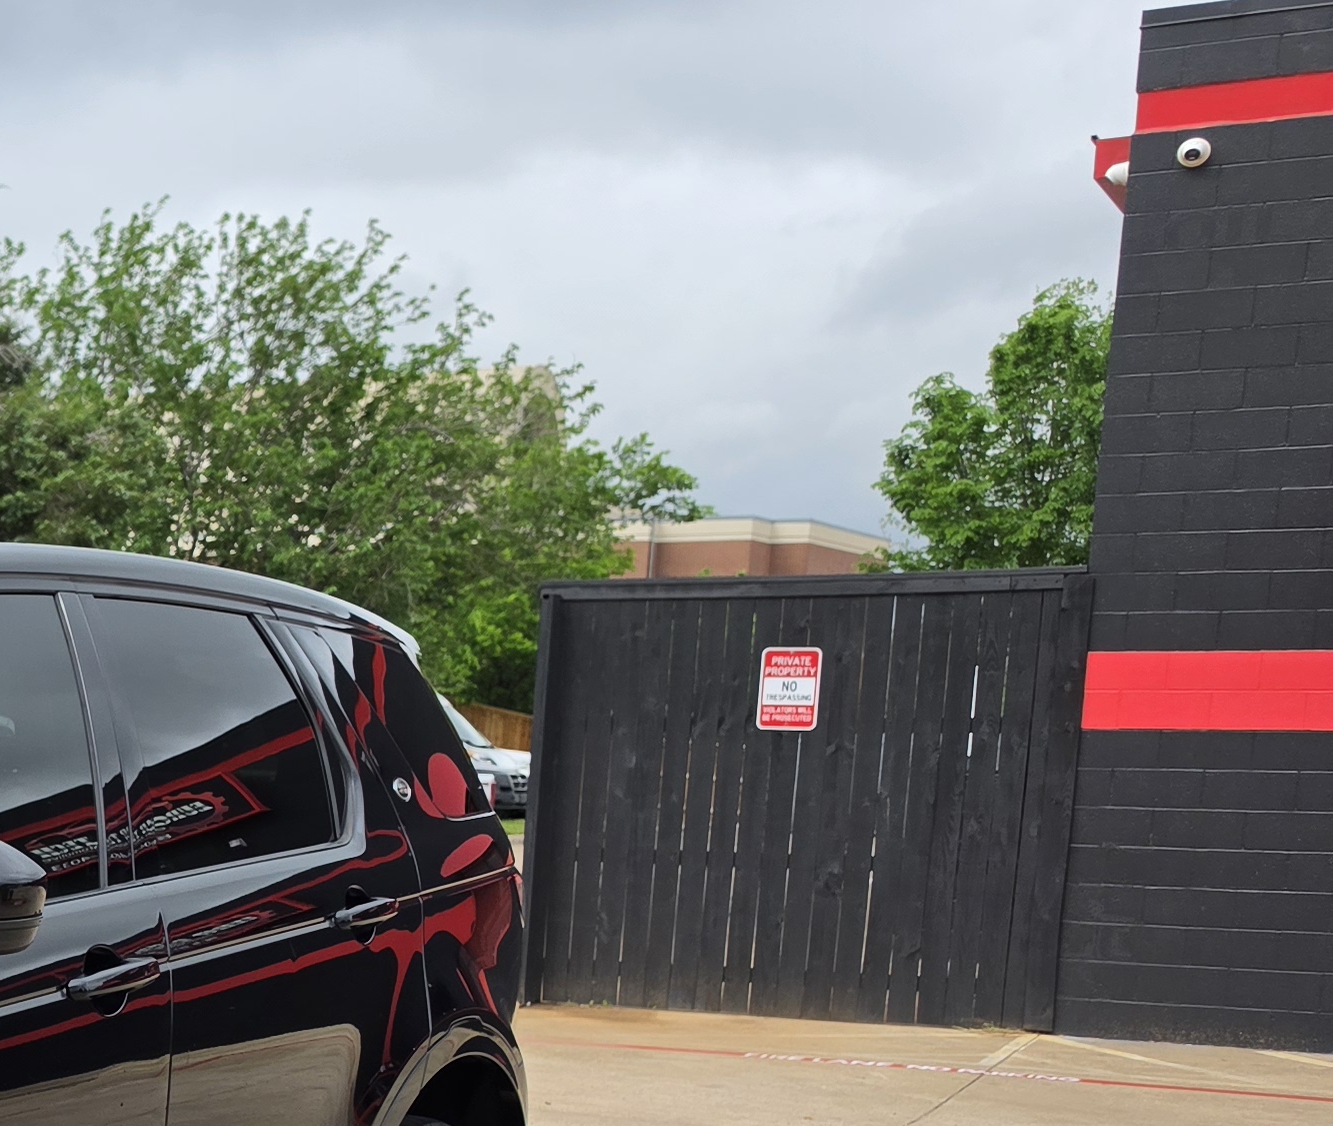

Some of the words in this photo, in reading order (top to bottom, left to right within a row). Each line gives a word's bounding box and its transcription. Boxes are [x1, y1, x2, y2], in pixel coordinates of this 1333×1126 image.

[771, 656, 812, 666] PRIVATE
[765, 666, 816, 676] PROPERTY
[781, 681, 798, 692] NO
[766, 693, 811, 701] TRESPASSING
